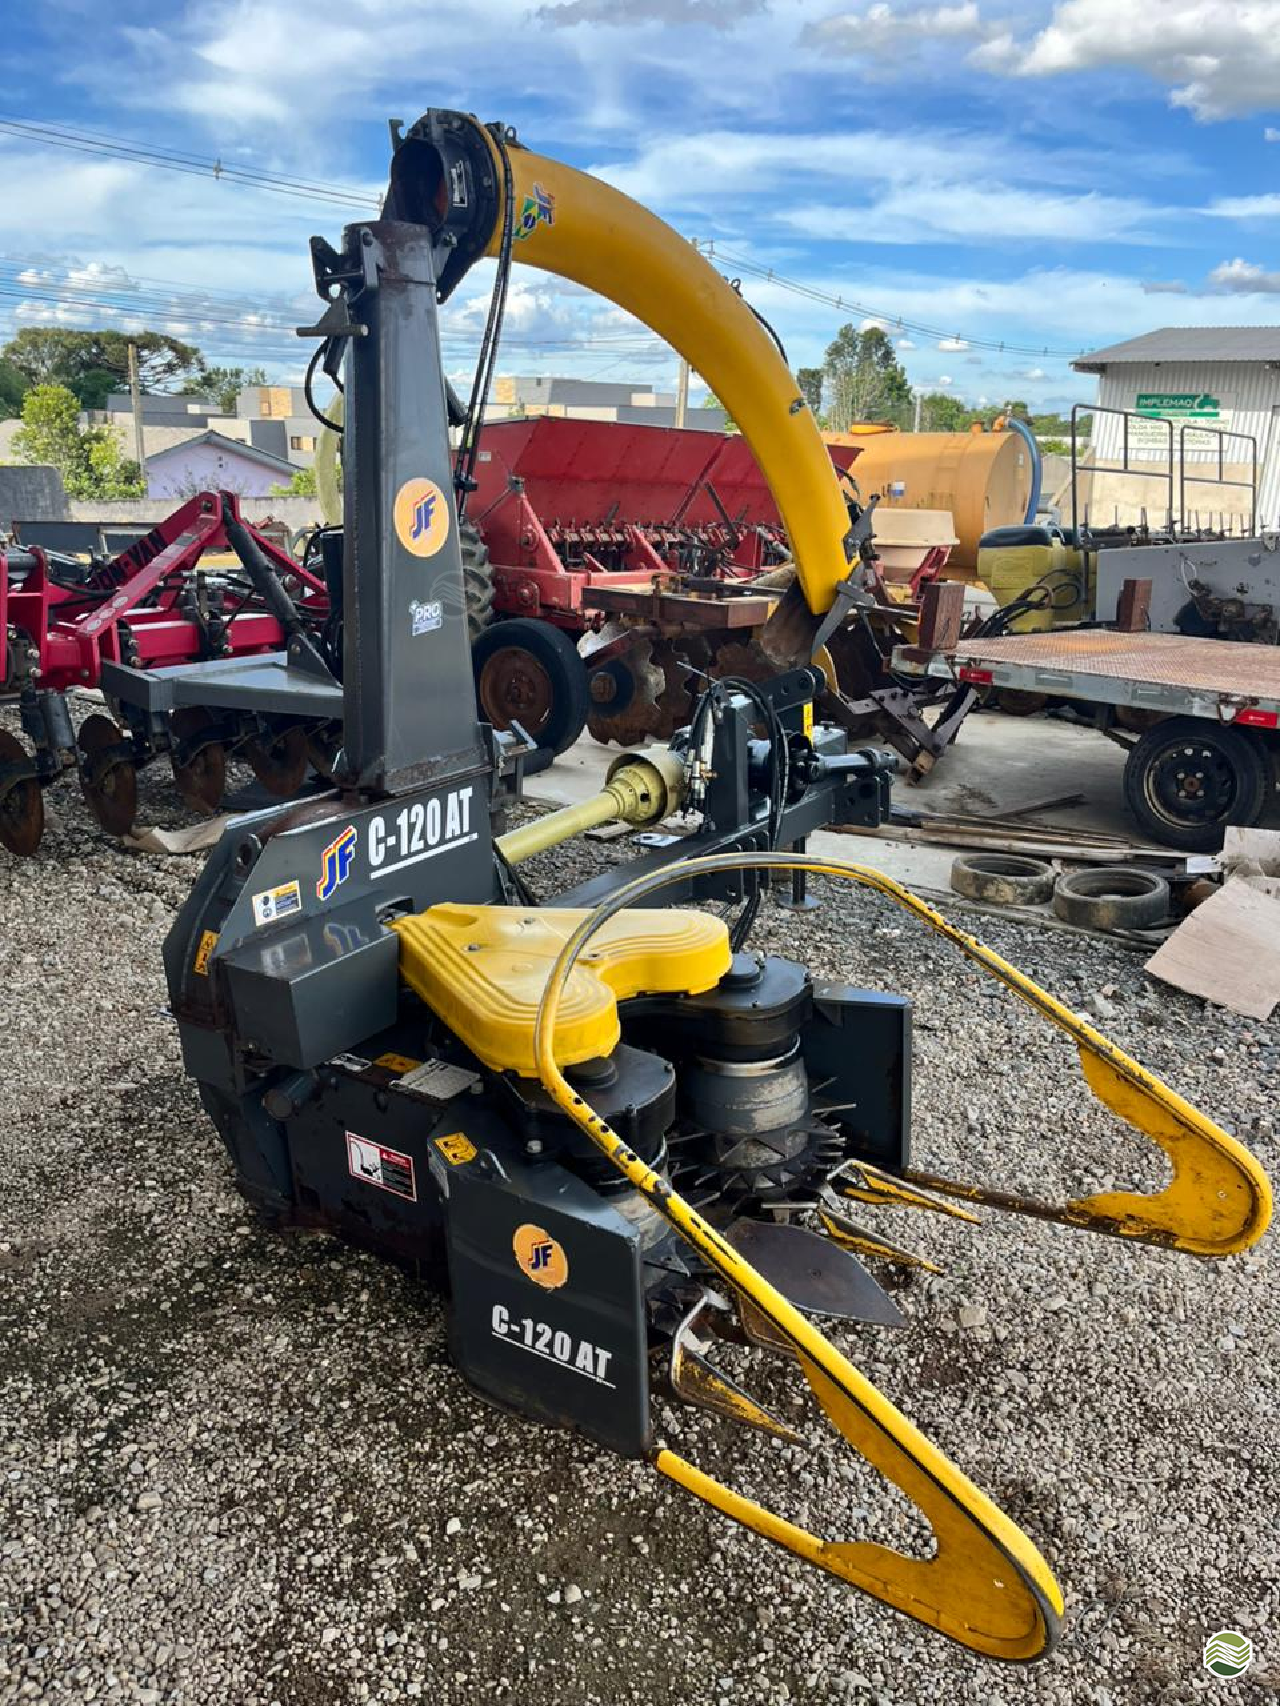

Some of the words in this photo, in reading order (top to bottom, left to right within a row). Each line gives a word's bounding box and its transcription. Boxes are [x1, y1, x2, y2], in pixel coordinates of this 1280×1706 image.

[1140, 398, 1193, 409] IMPLEMAQ
[410, 490, 437, 540] JF
[415, 603, 441, 623] PRO
[368, 797, 441, 867] C-120
[445, 786, 473, 839] AT
[316, 825, 358, 901] JF
[528, 1240, 554, 1270] JF
[492, 1304, 572, 1362] C-120
[576, 1341, 612, 1379] AT
